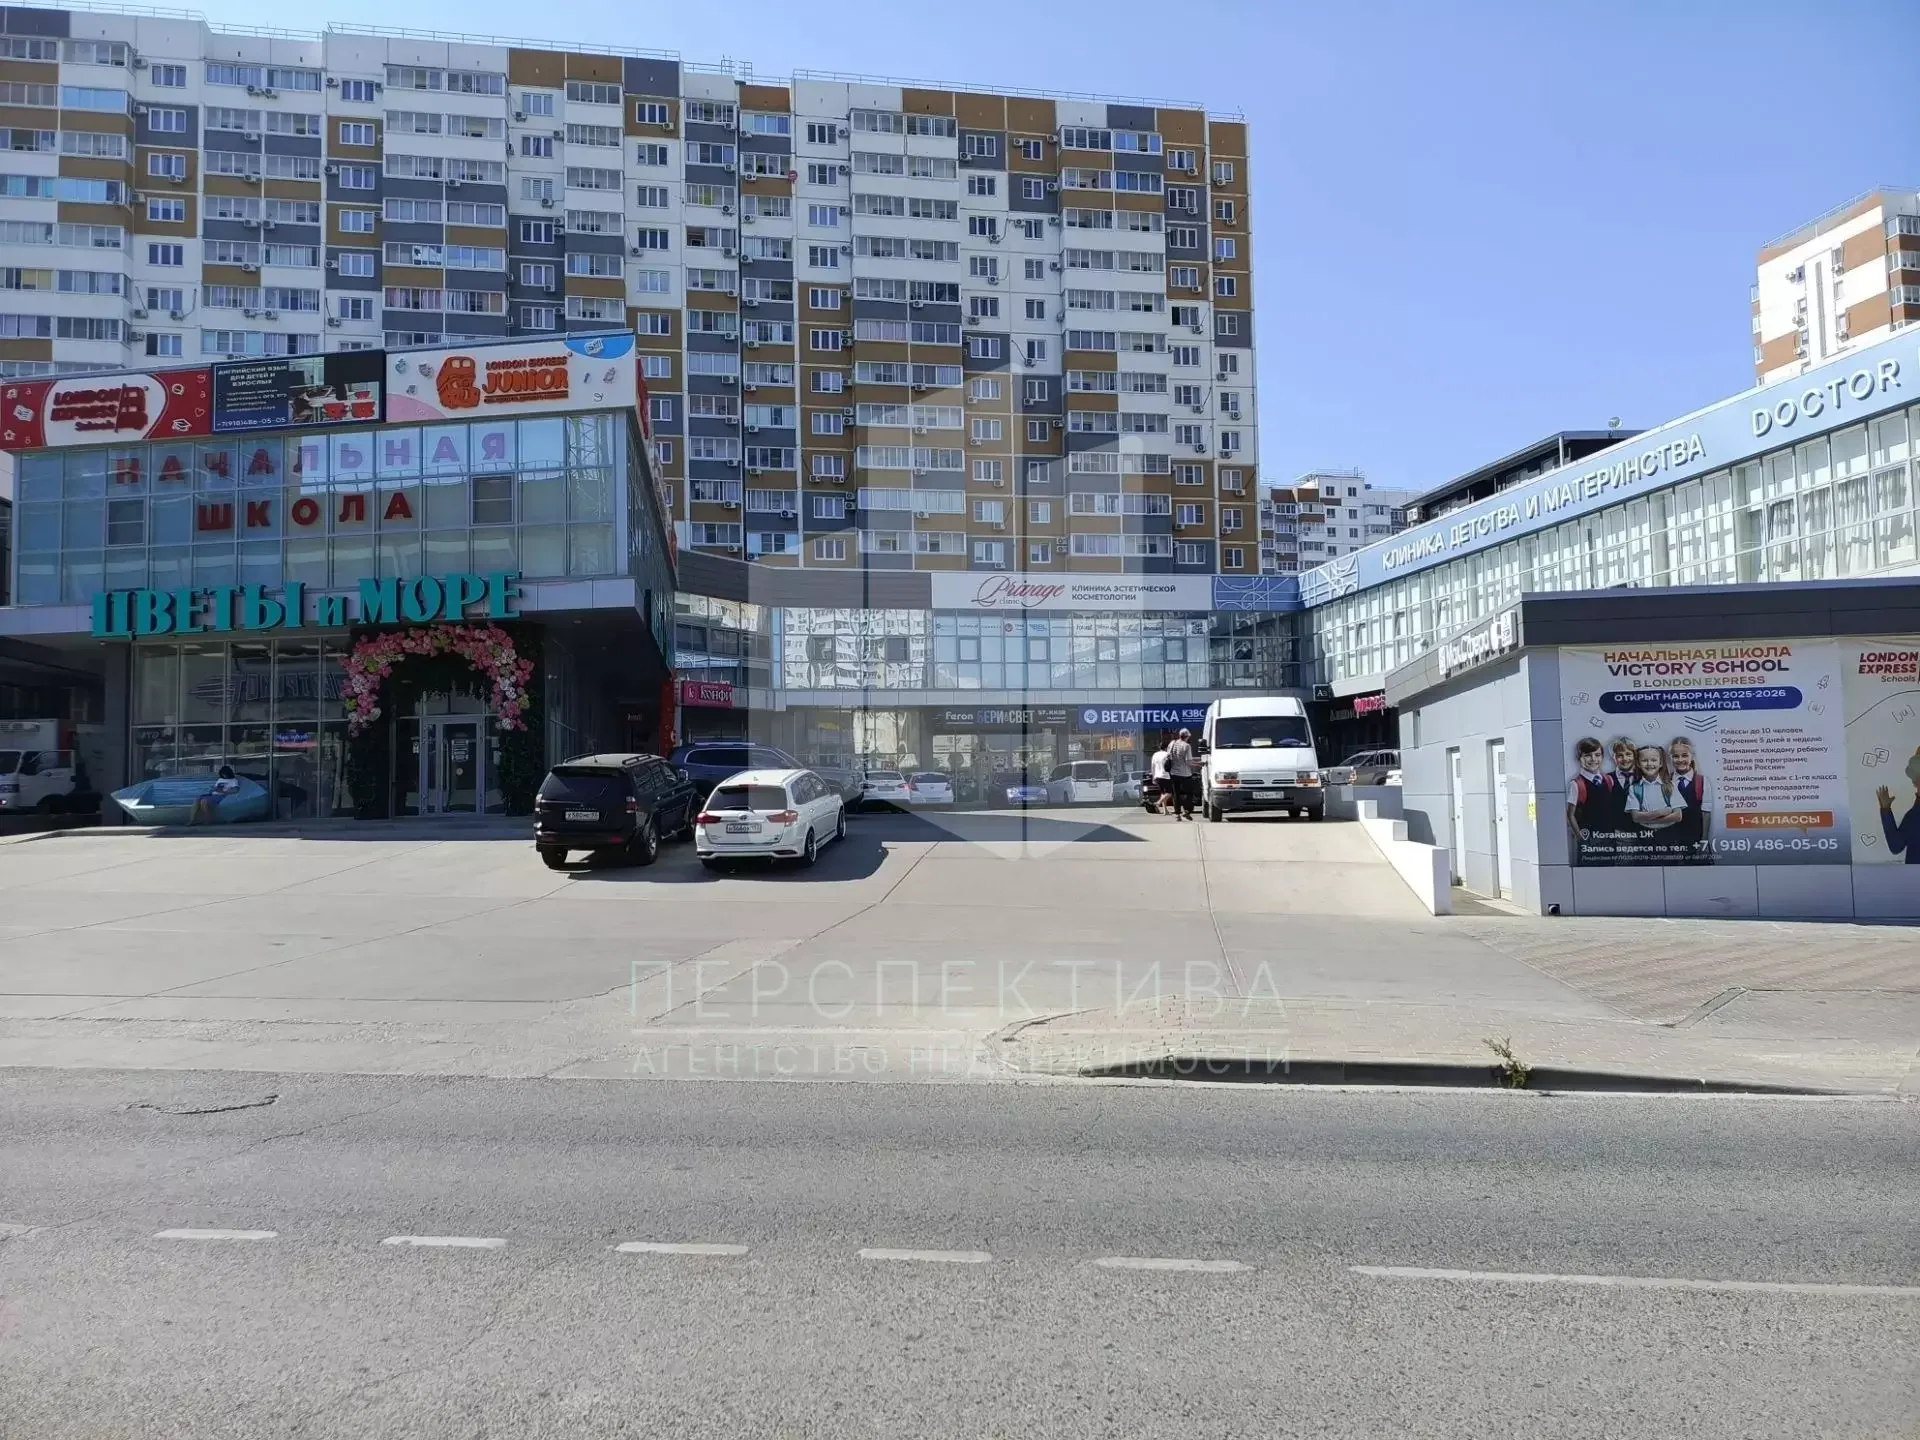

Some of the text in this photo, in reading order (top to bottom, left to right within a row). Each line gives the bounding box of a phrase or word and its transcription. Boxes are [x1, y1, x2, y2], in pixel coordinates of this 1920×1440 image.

[485, 356, 567, 370] LONDON EXPRESS
[218, 367, 266, 375] АНГЛИЙСКИЙ
[482, 367, 568, 394] JUNIOR
[1752, 358, 1901, 437] DOCTOR
[116, 432, 505, 484] НАЧАЛЬНАЯ
[1382, 434, 1706, 571] КЛИНИКА ДЕТСТВА И МАТЕРИНСТВА
[198, 492, 413, 531] ШКОЛА
[1114, 584, 1176, 592] ЭСТЕТИЧЕСКОЙ
[1072, 593, 1136, 601] КОСМЕТОЛОГИИ
[91, 581, 305, 640] ЦВЕТЫ
[358, 571, 522, 624] МОРЕ
[1604, 646, 1792, 663] НАЧАЛЬНАЯ ШКОЛА
[1859, 651, 1919, 663] LONDON
[1608, 659, 1789, 676] VICTORY SCHOOL
[1858, 664, 1917, 675] EXPRESS
[1644, 678, 1702, 687] LONDON
[1705, 676, 1766, 685] EXPRESS
[1614, 689, 1786, 702] ОТКРЫТ НАБОР НА 2025-2026
[1660, 700, 1741, 710] УЧЕБНЫЙ ГОД
[945, 711, 973, 720] Feron
[1102, 710, 1179, 722] ВЕТАПТЕКА
[1721, 737, 1758, 745] Обучение
[1766, 736, 1785, 744] дней
[1797, 745, 1828, 753] ребенку
[1792, 794, 1819, 802] уроков
[1762, 815, 1820, 824] КЛАССЫ
[1592, 830, 1654, 839] Котанова 1Ж
[1581, 844, 1614, 853] Запись
[1616, 845, 1653, 853] ведется
[1754, 838, 1839, 850] 486-05-05
